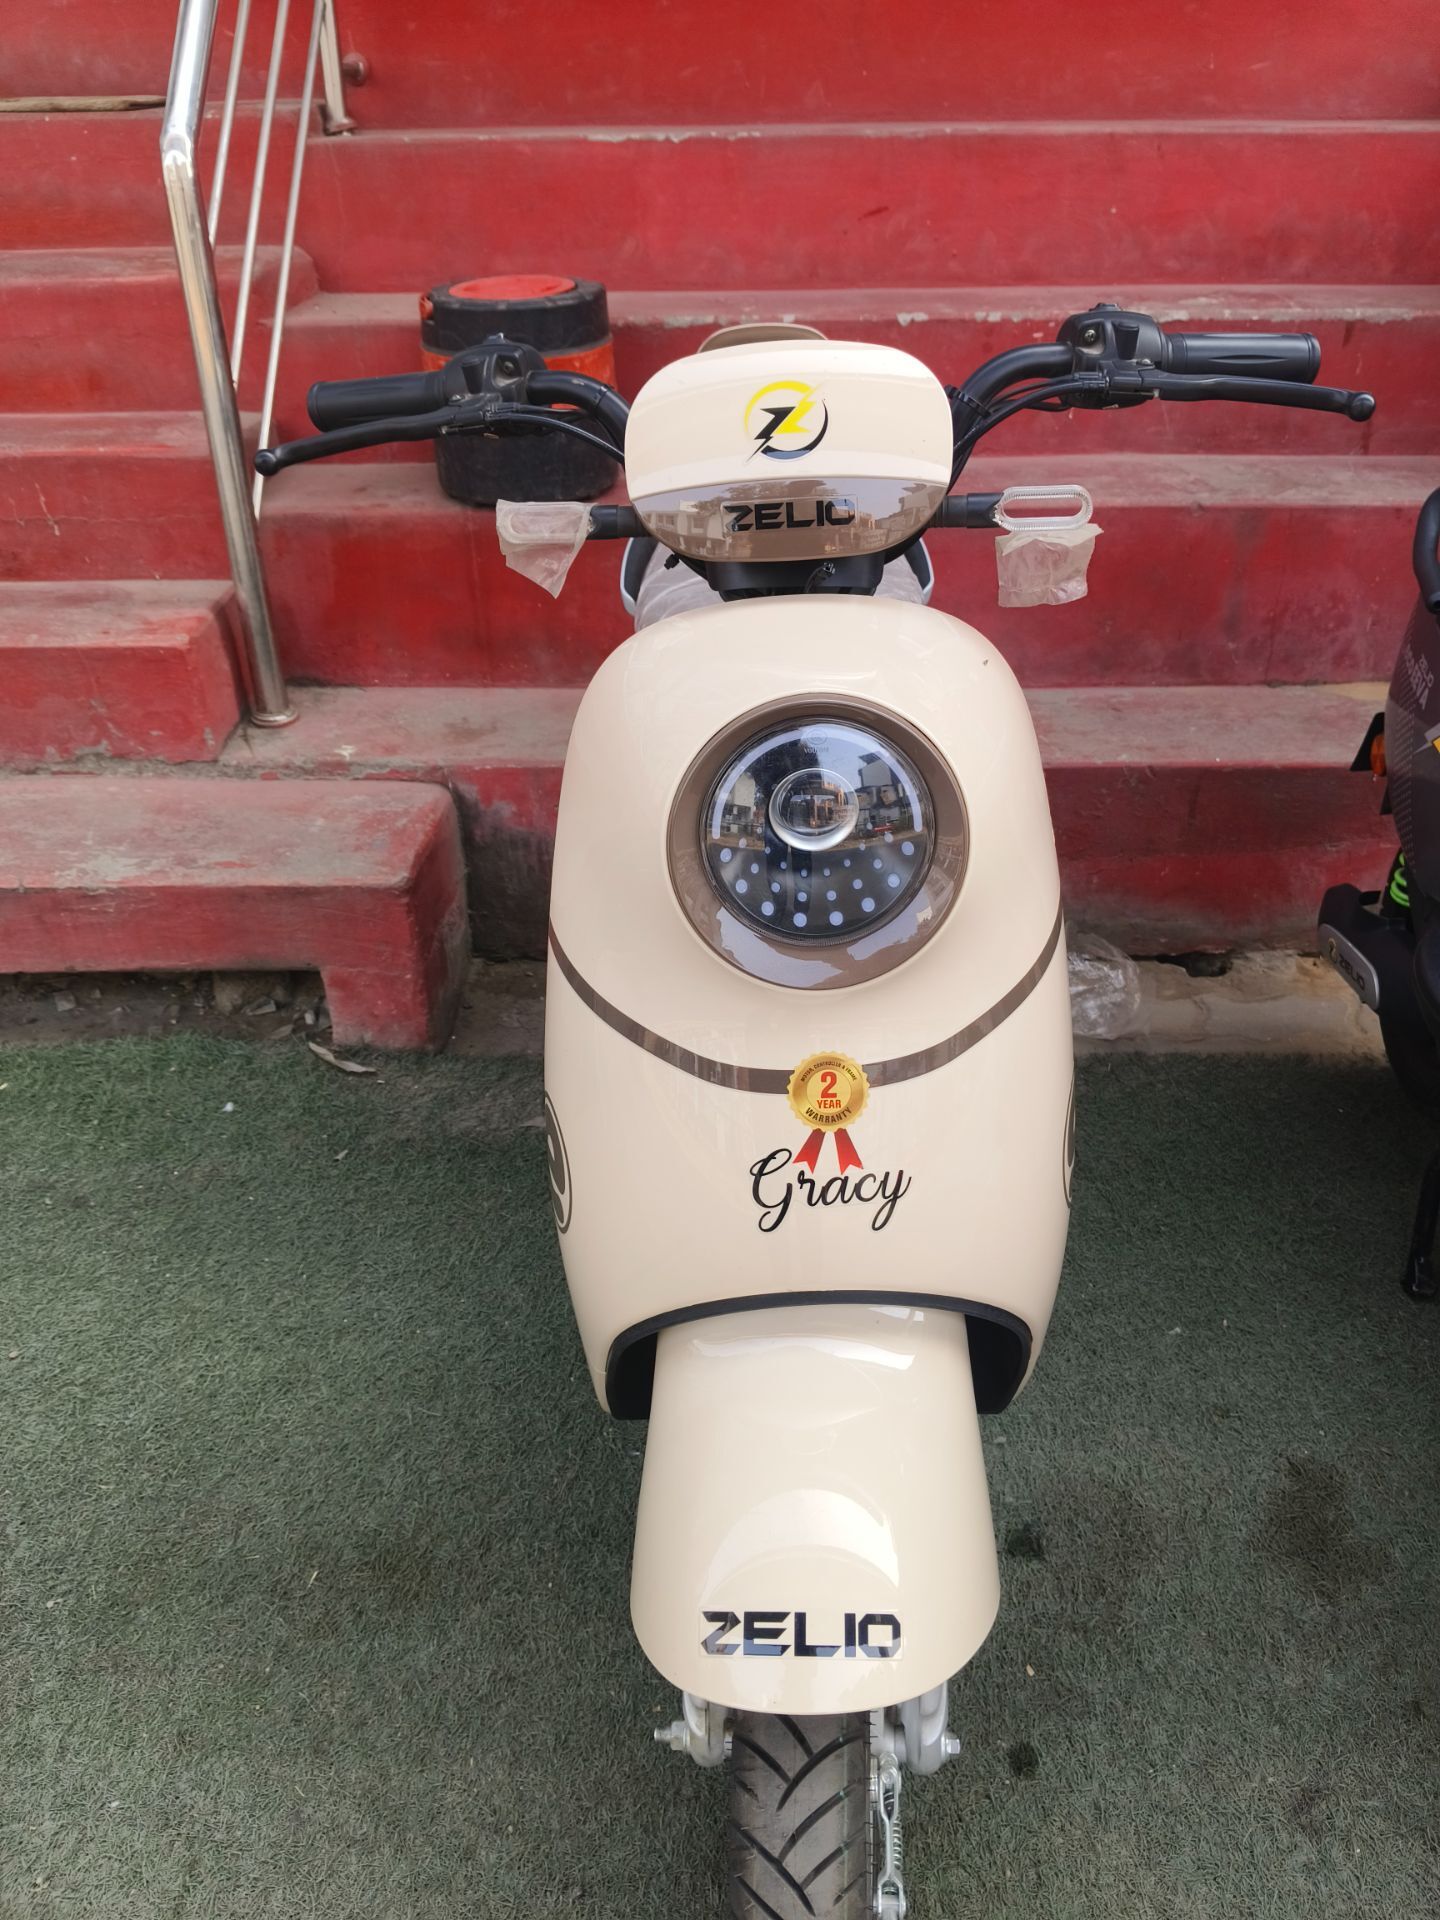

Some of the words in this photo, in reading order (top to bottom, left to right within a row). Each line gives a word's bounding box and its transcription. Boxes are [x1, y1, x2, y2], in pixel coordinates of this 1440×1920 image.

[723, 498, 856, 532] ZELIO
[820, 1071, 837, 1099] 2
[805, 1106, 852, 1123] WARRANTY
[816, 1099, 842, 1109] YEAR
[749, 1147, 912, 1233] Gracy
[700, 1610, 901, 1658] ZELIO
